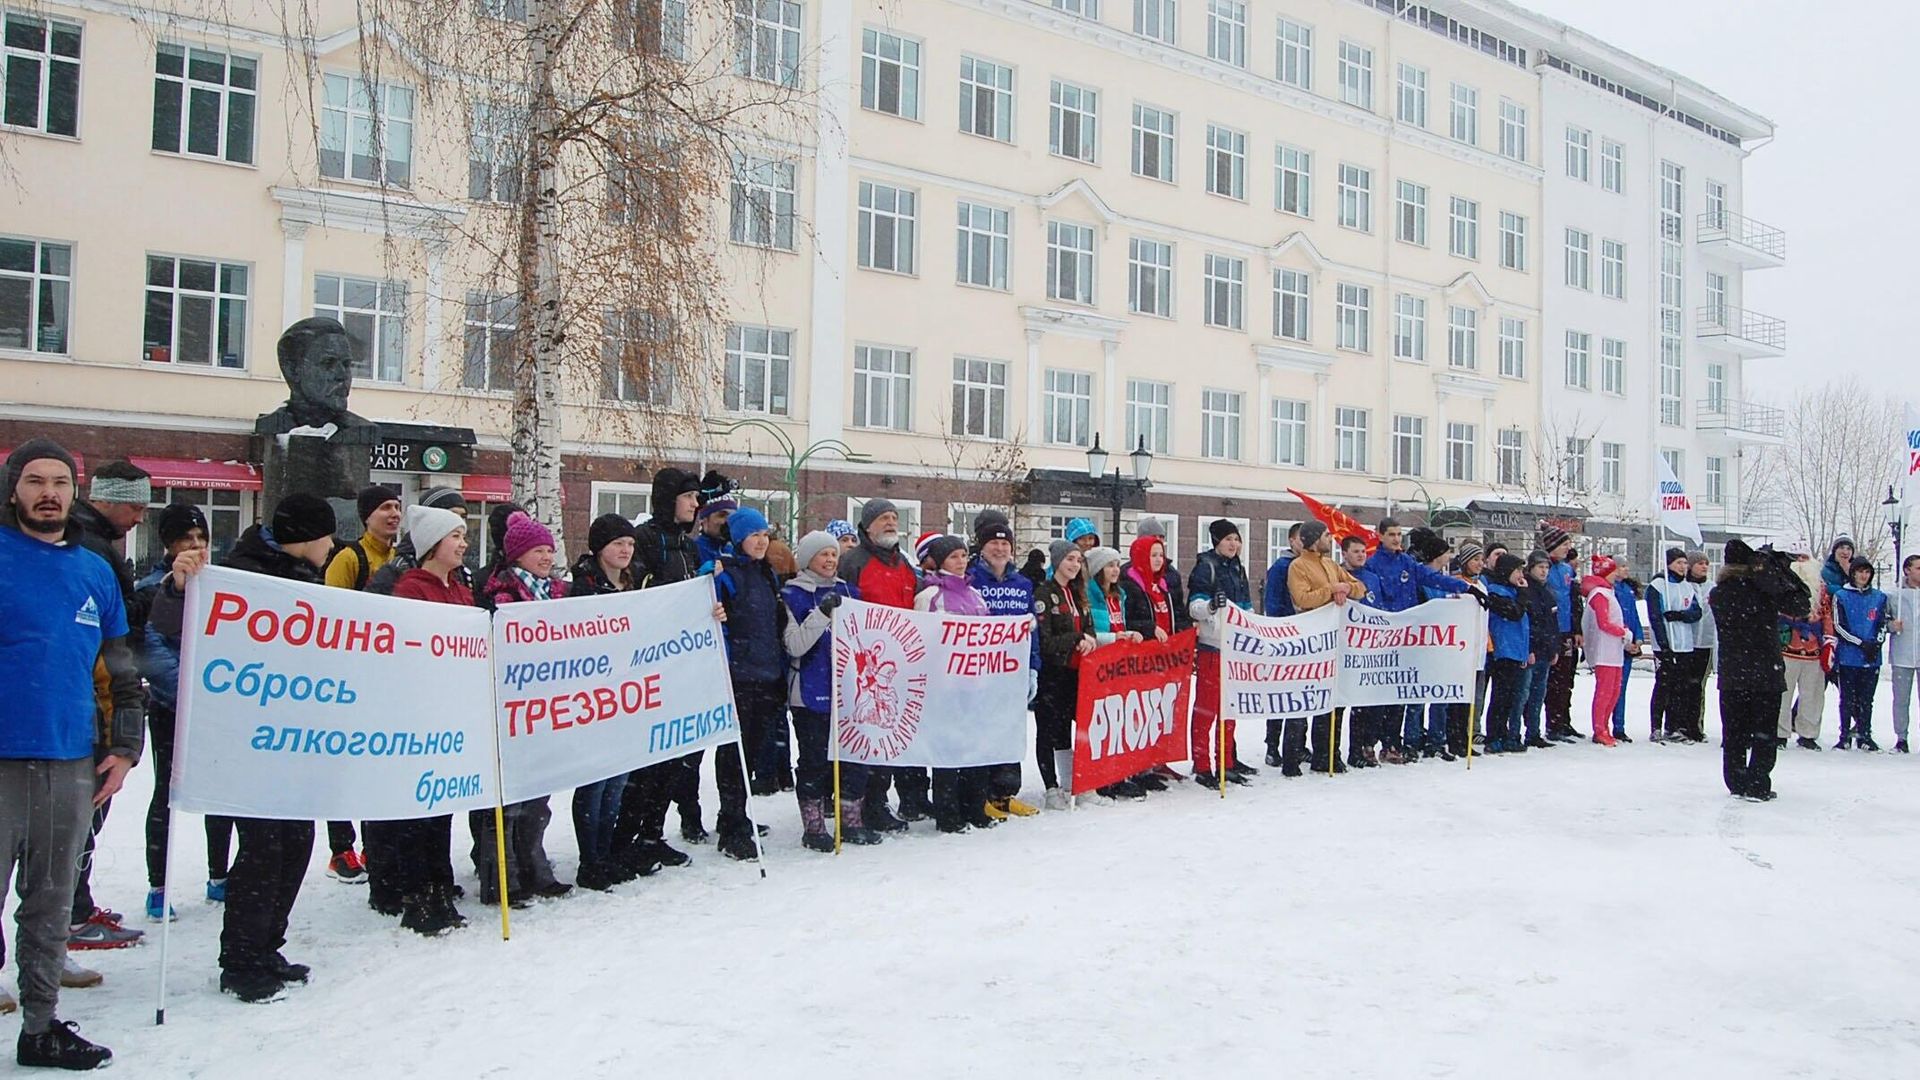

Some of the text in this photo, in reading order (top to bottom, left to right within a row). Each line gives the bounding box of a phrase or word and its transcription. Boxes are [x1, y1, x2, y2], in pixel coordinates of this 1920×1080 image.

[370, 443, 410, 456] HOP
[204, 591, 396, 655] Родина
[505, 614, 631, 644] Подымайся
[941, 620, 1031, 647] ТРЕЗВАЯ
[1268, 629, 1339, 657] МЫСЛИ
[1345, 624, 1467, 652] ТРЕЗВЫМ,
[503, 654, 614, 691] крепкое,
[947, 650, 1020, 676] ПЕРМЬ
[1227, 659, 1337, 682] МЫСЛЯЩИ
[1344, 649, 1400, 669] ВЕЛИКИЙ
[202, 658, 358, 707] Сбрось
[1359, 666, 1419, 686] РУССКИЙ
[503, 673, 663, 738] ТРЕЗВОЕ
[1237, 692, 1265, 714] НЕ
[1396, 684, 1465, 699] НАРОД!
[250, 724, 465, 756] алкогольное
[649, 703, 734, 753] ПЛЕМЯ!
[414, 769, 484, 810] бремя.
